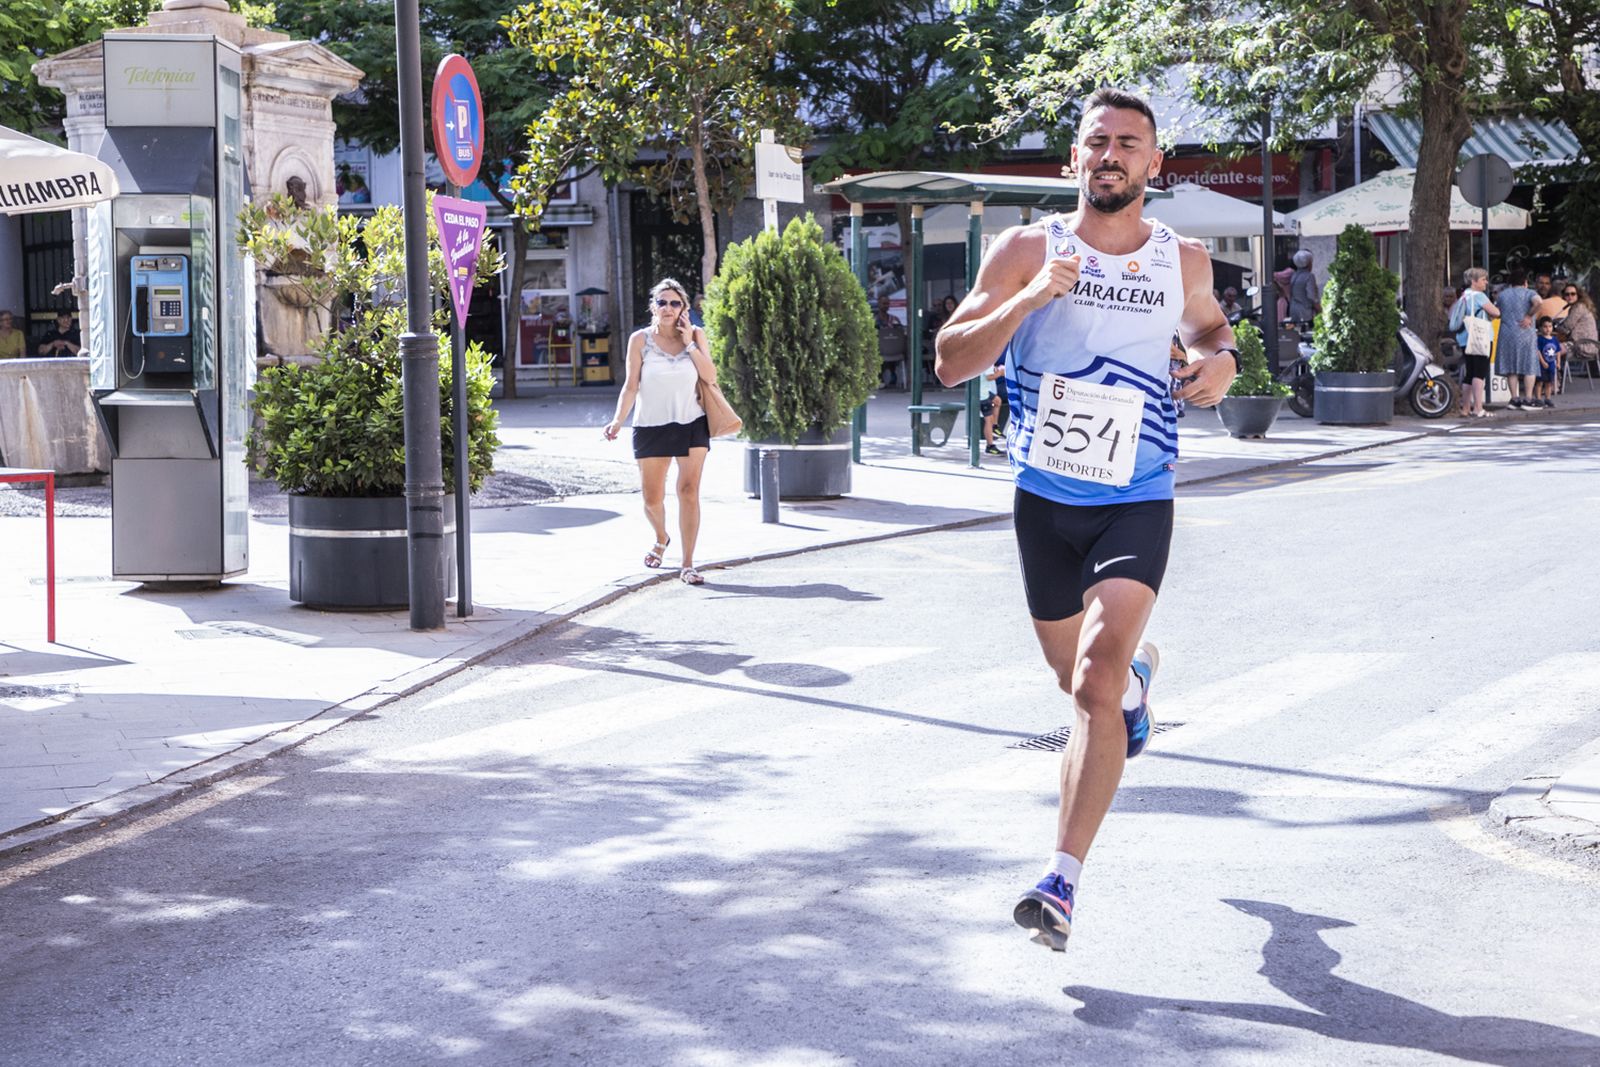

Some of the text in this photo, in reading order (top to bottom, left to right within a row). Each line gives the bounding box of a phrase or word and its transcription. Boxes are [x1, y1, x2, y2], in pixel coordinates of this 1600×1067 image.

[457, 105, 468, 138] P
[458, 148, 472, 158] BUS
[1166, 170, 1244, 186] Occidente
[444, 212, 479, 229] CEDA EL PASO
[1074, 299, 1095, 307] CLUB
[1107, 304, 1152, 314] ATLETISMO
[1066, 387, 1101, 401] Diputación
[1101, 393, 1108, 401] de
[1108, 395, 1134, 404] Granada
[1042, 408, 1121, 462] 554
[1046, 456, 1114, 480] DEPORTES
